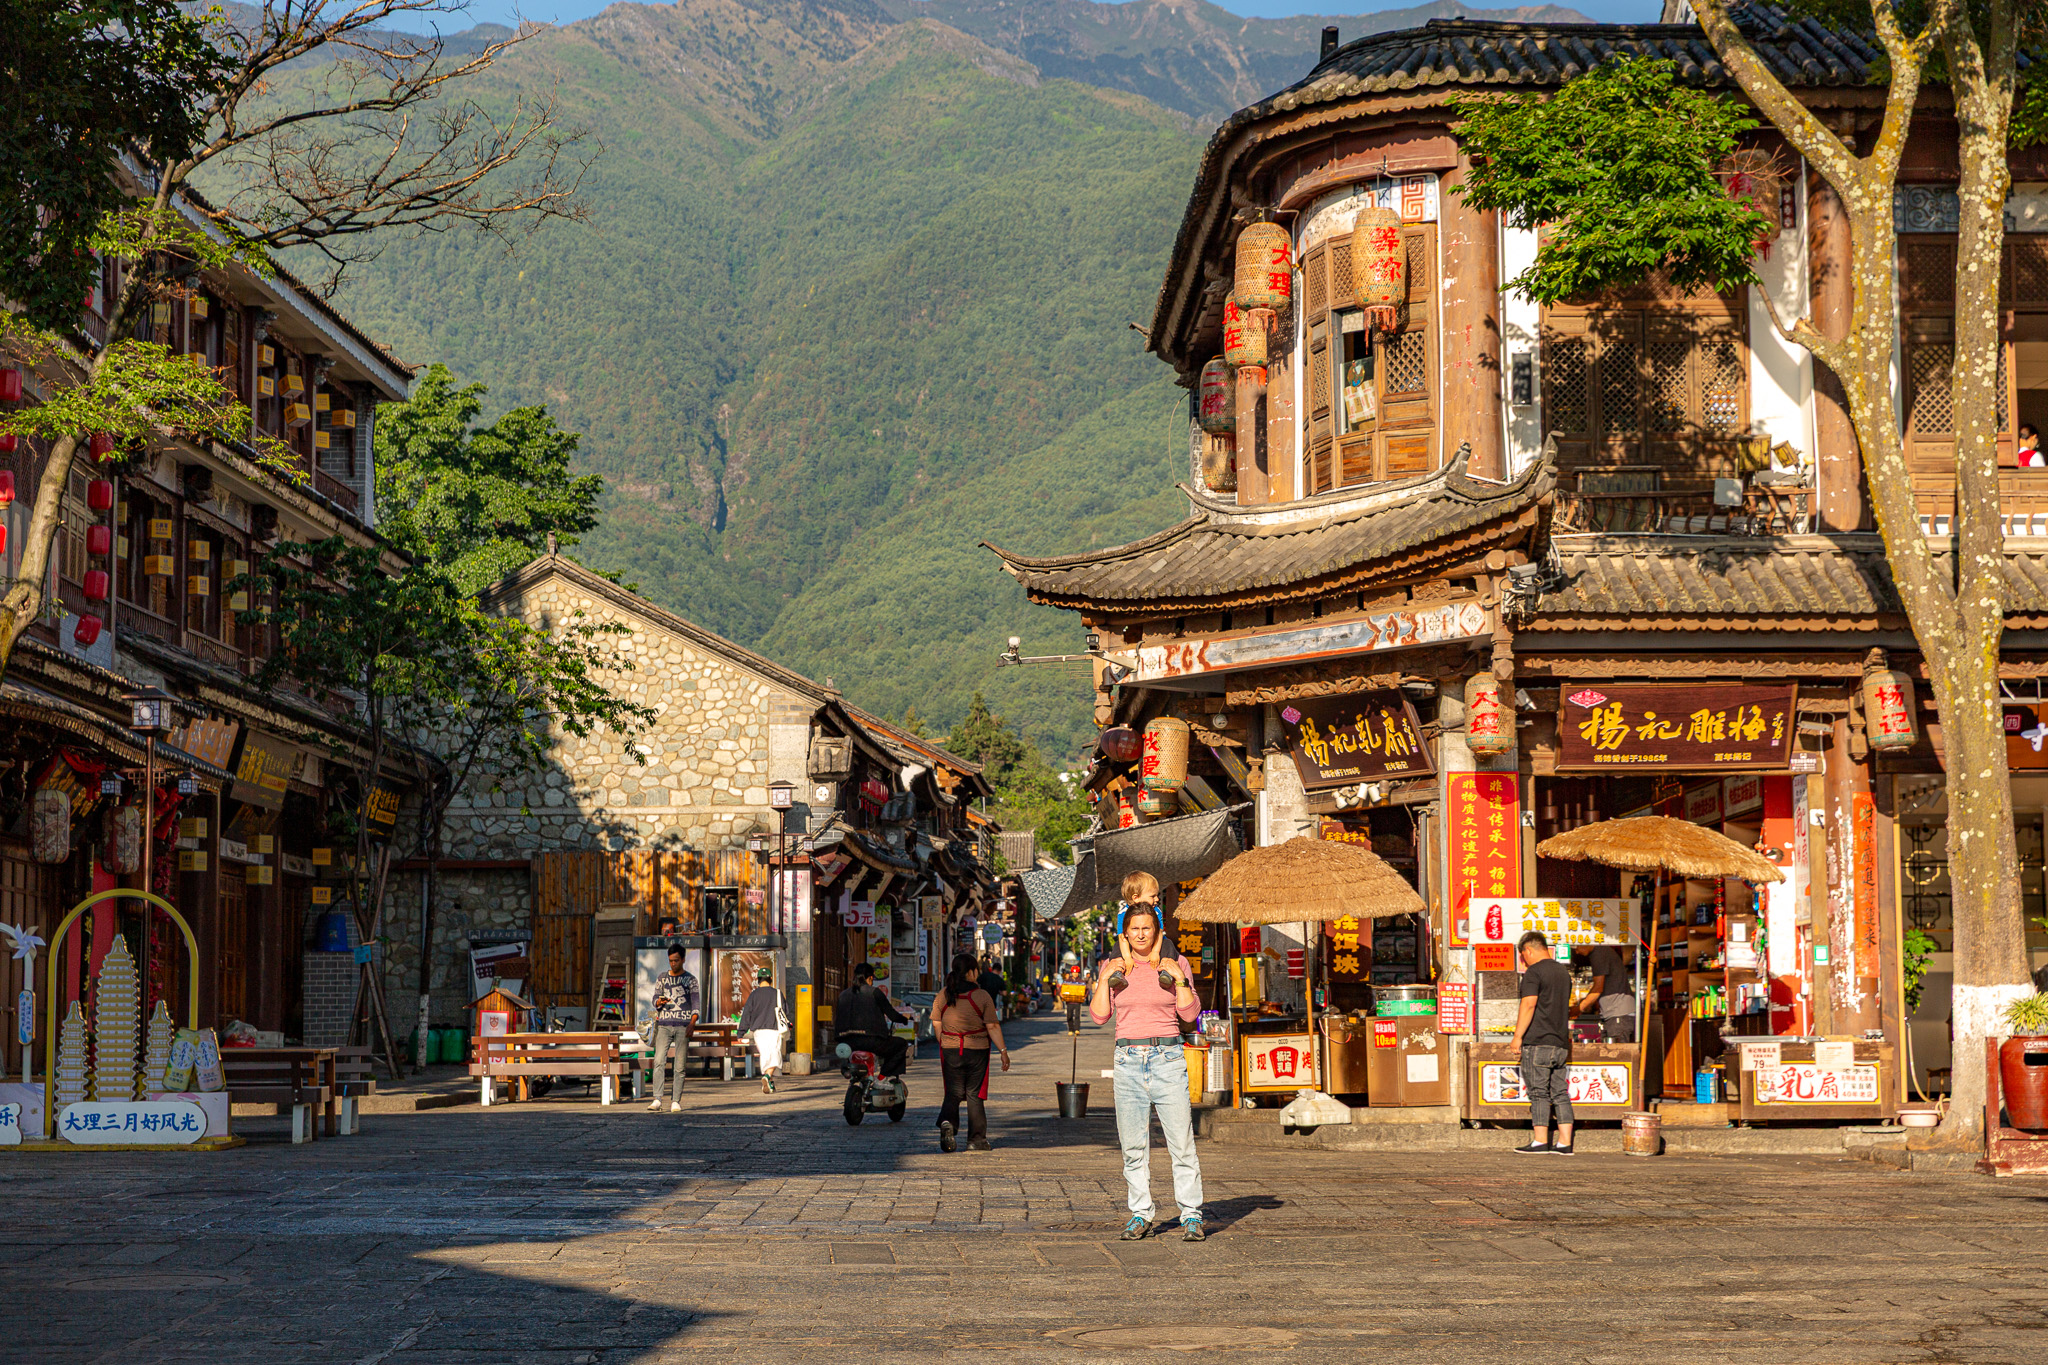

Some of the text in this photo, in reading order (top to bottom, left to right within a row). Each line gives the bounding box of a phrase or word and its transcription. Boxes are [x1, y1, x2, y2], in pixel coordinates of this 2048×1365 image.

[1368, 226, 1402, 283] 等你
[1268, 243, 1292, 296] 大理
[1222, 301, 1243, 353] 我在
[1874, 684, 1911, 735] 杨记
[1714, 752, 1751, 762] 百年杨记
[1487, 779, 1507, 858] 非遗传承人
[1325, 831, 1366, 843] 正宗老字号
[1488, 906, 1501, 938] 老字号
[1522, 900, 1605, 919] 大理杨记
[1522, 919, 1558, 932] 烤乳扇
[655, 1010, 691, 1021] ADNESS
[1753, 1059, 1765, 1069] 79
[1777, 1066, 1839, 1099] 乳扇
[64, 1112, 199, 1132] 大理三月好风光
